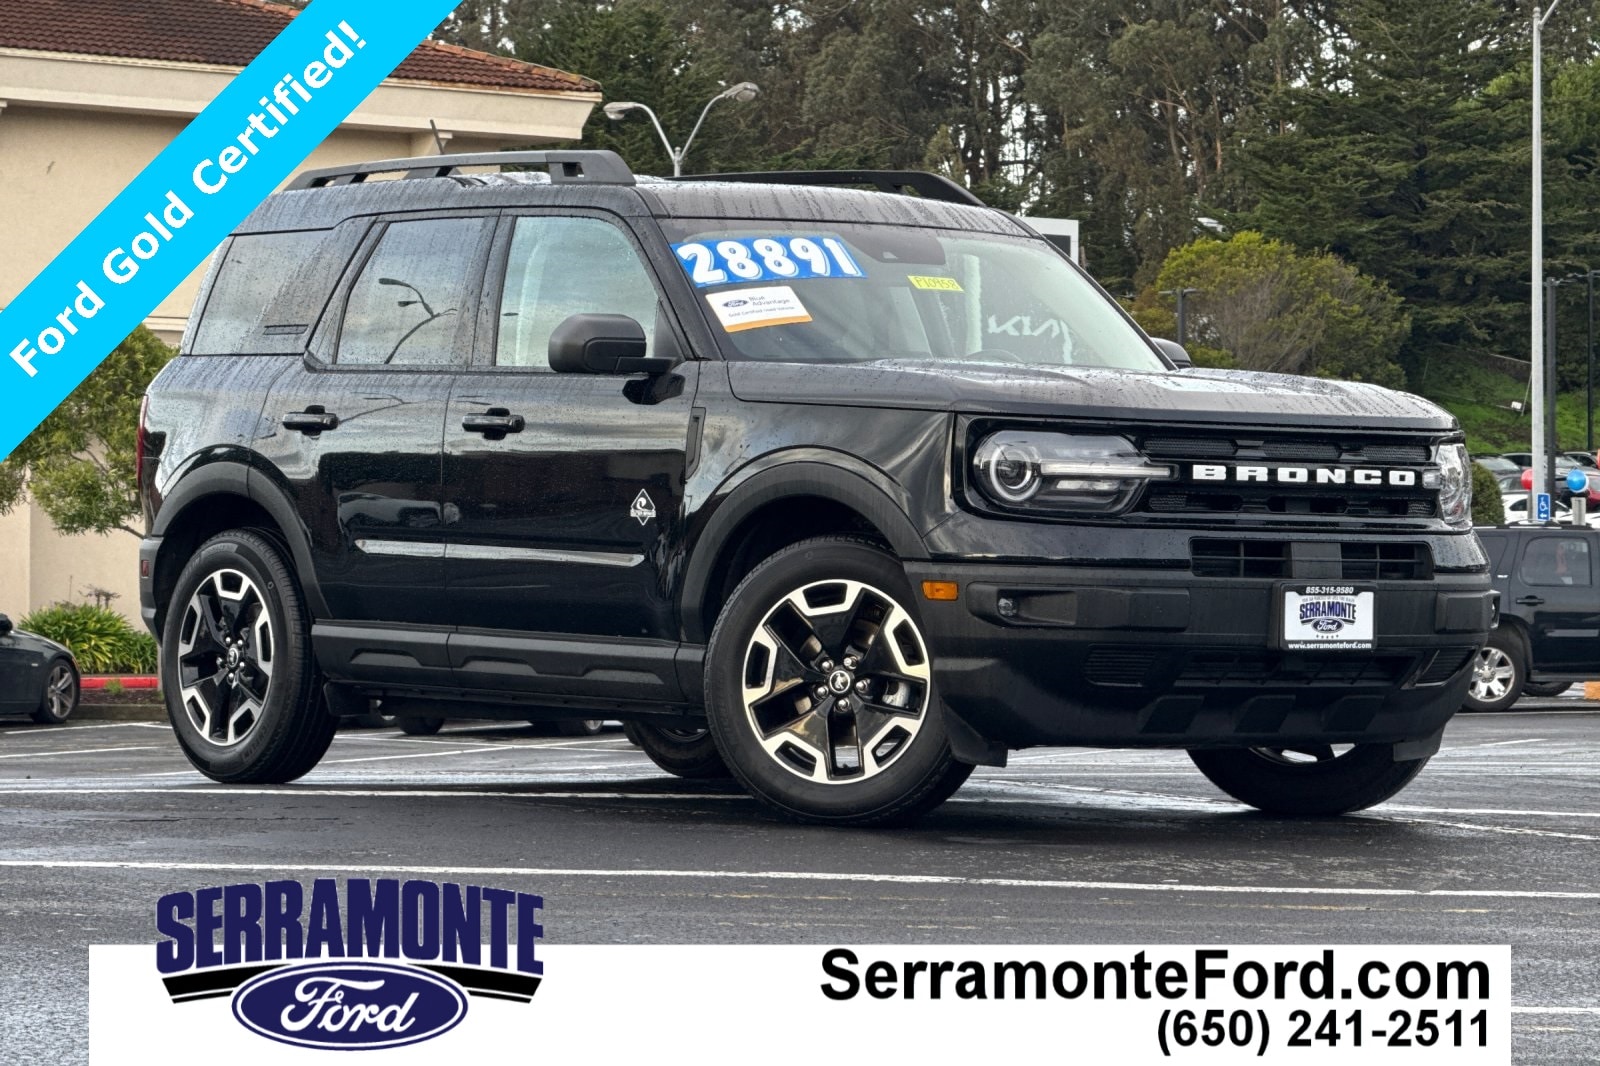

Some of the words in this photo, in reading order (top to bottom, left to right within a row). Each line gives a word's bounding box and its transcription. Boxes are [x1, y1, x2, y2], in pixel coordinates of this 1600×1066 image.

[677, 238, 862, 284] 28891
[1192, 464, 1416, 486] BRONCO
[1305, 586, 1355, 594] 855-315-9580
[1300, 601, 1356, 619] SERRAMONTE
[1317, 620, 1339, 631] Ford
